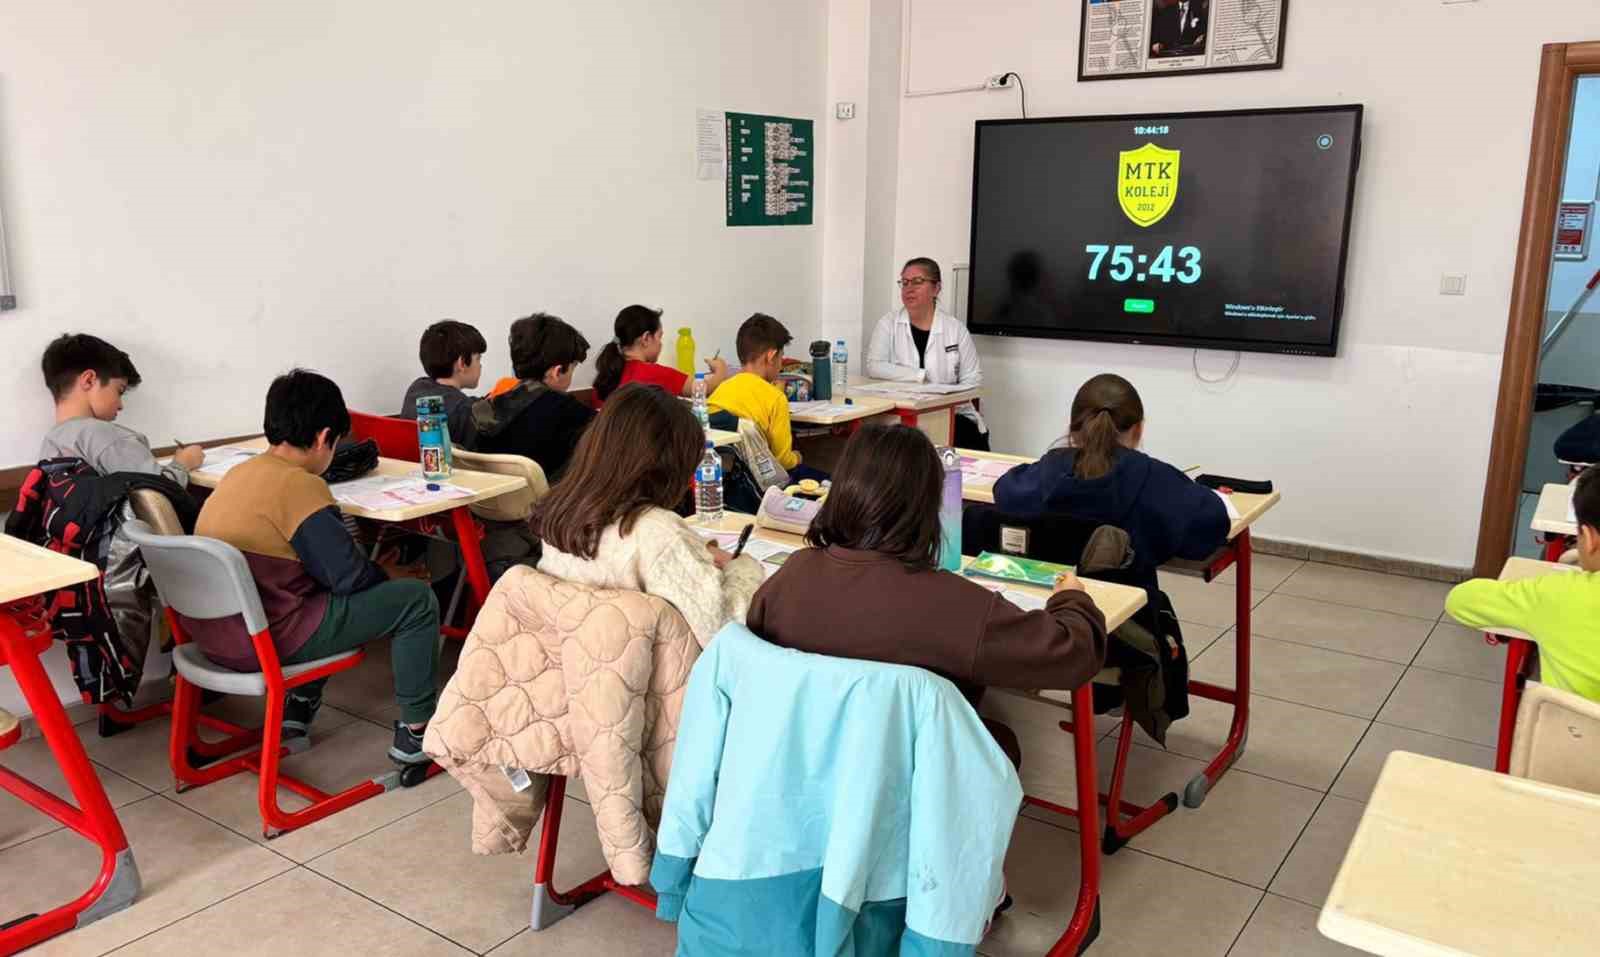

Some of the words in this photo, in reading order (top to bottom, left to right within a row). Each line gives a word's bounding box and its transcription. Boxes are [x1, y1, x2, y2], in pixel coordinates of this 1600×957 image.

[1125, 162, 1172, 180] MTK
[1125, 183, 1169, 198] KOLEJİ
[1137, 203, 1155, 212] 2012
[1085, 244, 1202, 284] 75:43
